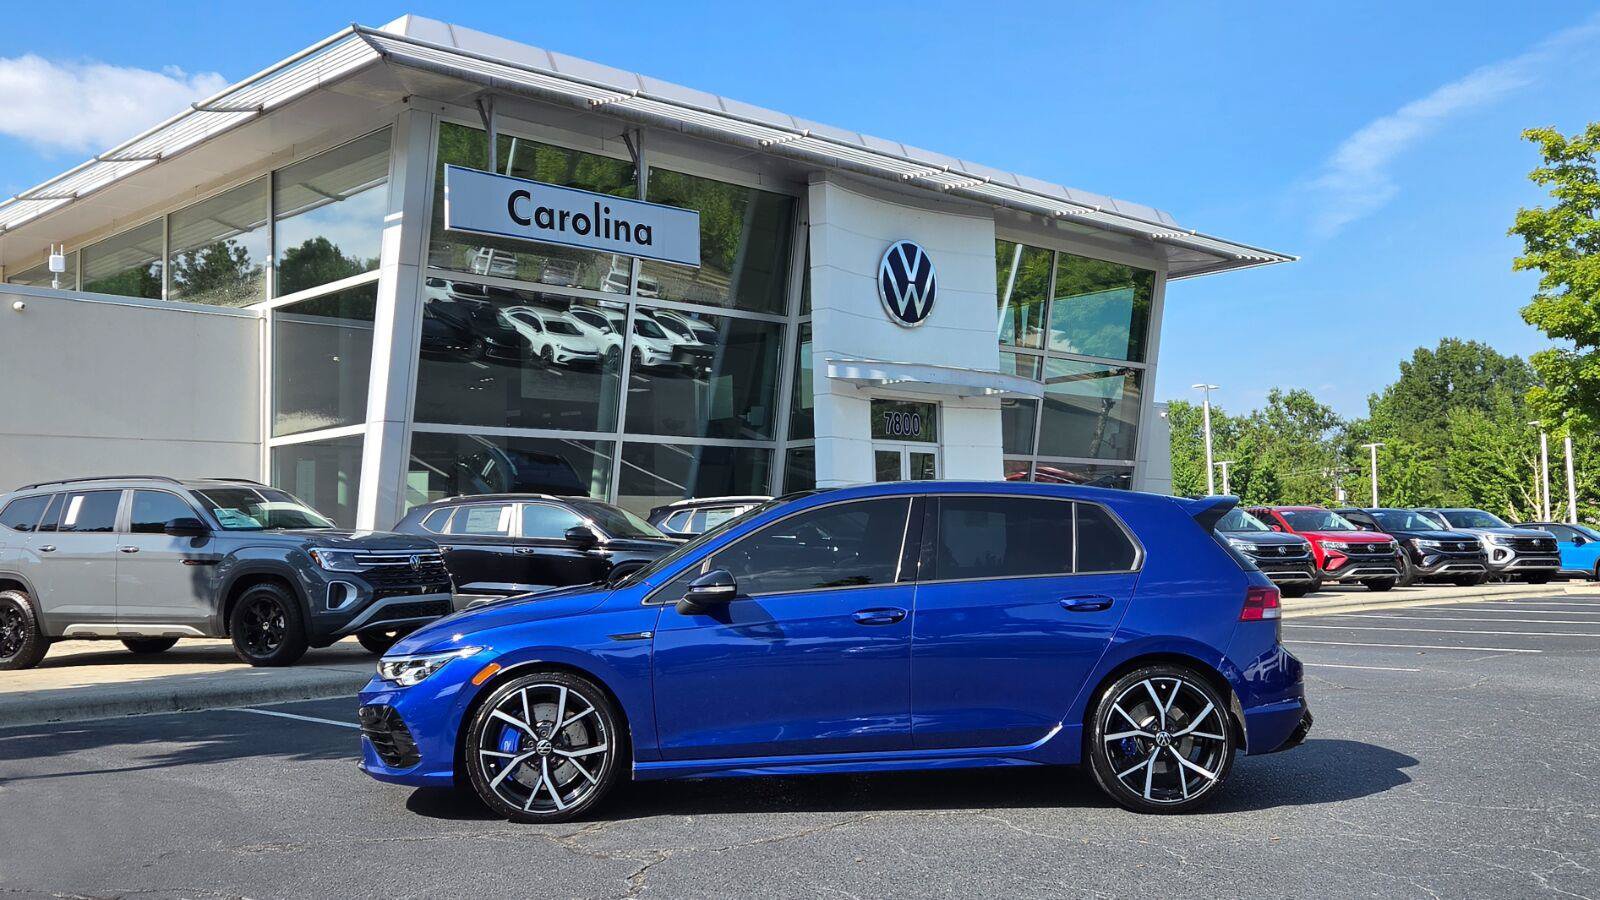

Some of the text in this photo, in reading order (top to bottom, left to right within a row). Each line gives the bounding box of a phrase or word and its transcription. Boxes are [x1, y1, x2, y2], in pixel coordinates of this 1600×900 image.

[507, 189, 653, 246] Carolina
[880, 240, 937, 324] VW
[884, 411, 920, 436] 7800
